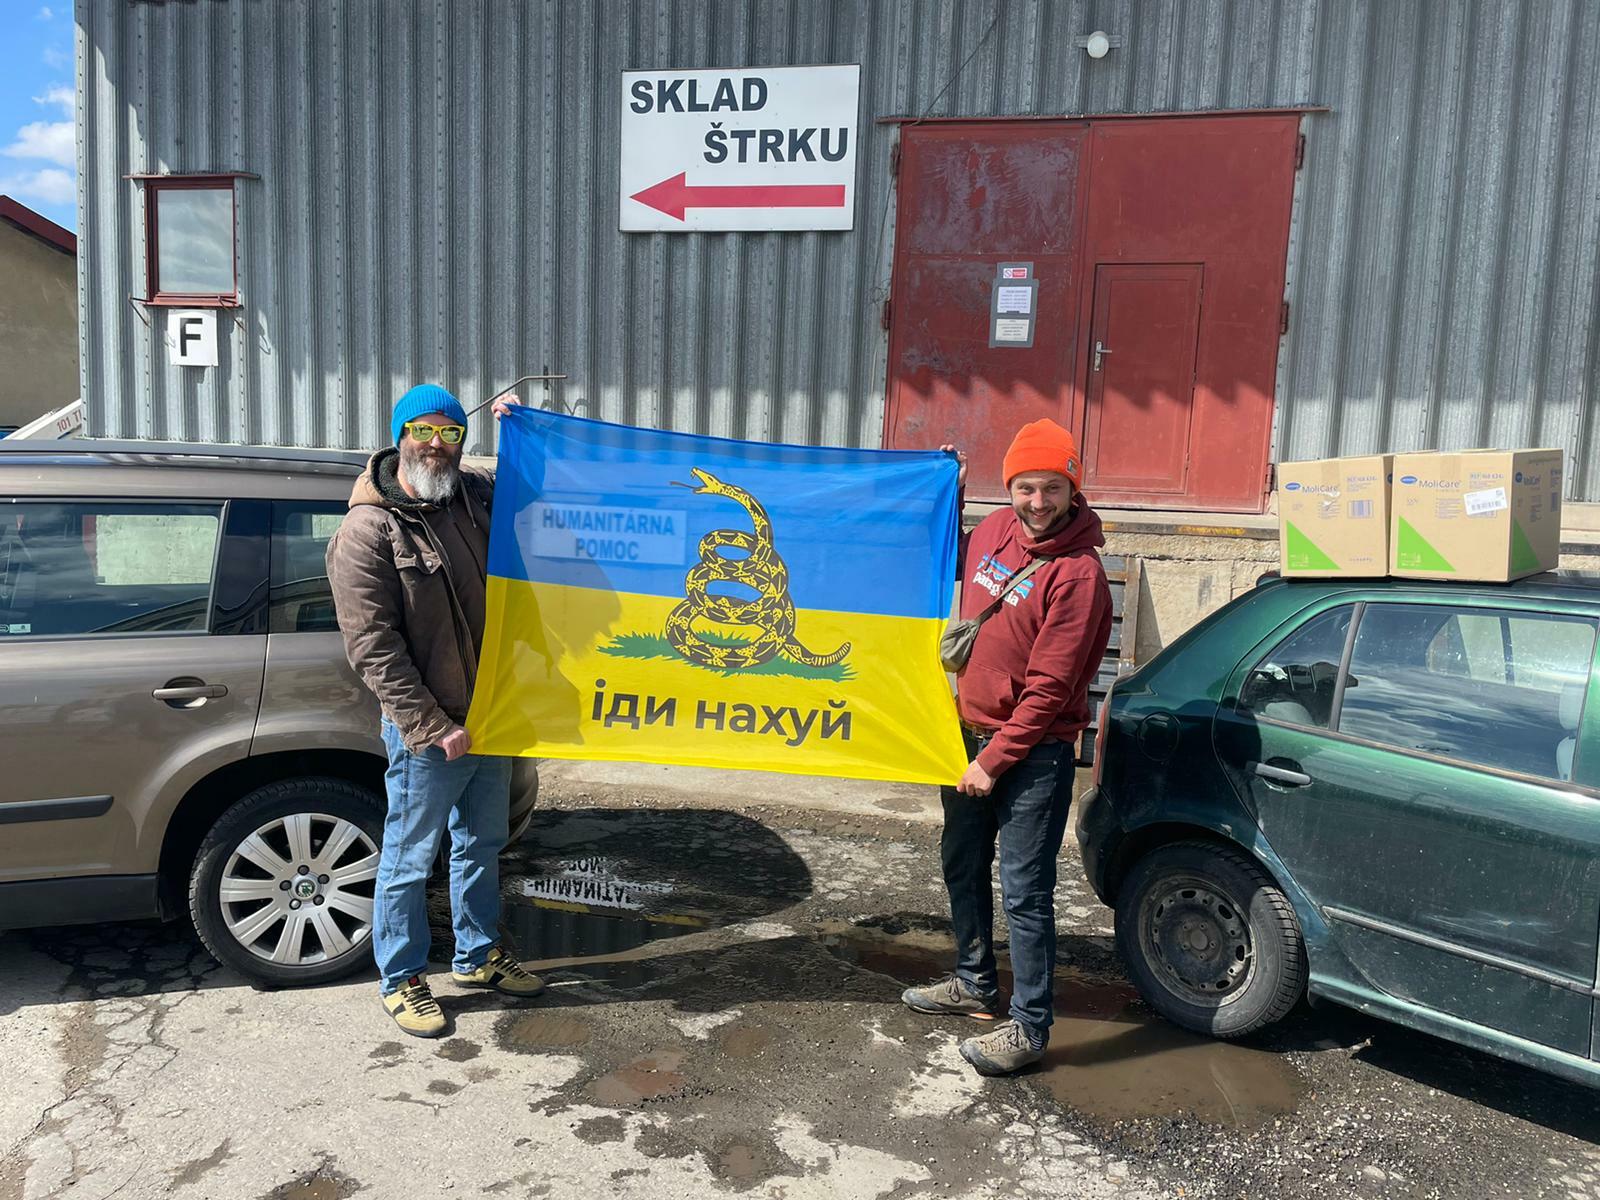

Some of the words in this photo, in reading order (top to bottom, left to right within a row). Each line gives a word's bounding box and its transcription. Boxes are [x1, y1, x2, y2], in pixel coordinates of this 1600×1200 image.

[630, 77, 768, 114] SKLAD
[703, 122, 848, 164] ŠTRKU
[179, 317, 203, 357] F
[57, 416, 71, 432] 101
[1418, 480, 1460, 489] MoliCare
[575, 537, 639, 560] POMOC
[973, 571, 1019, 607] patagia
[591, 678, 677, 730] іди
[695, 699, 852, 747] нахуй
